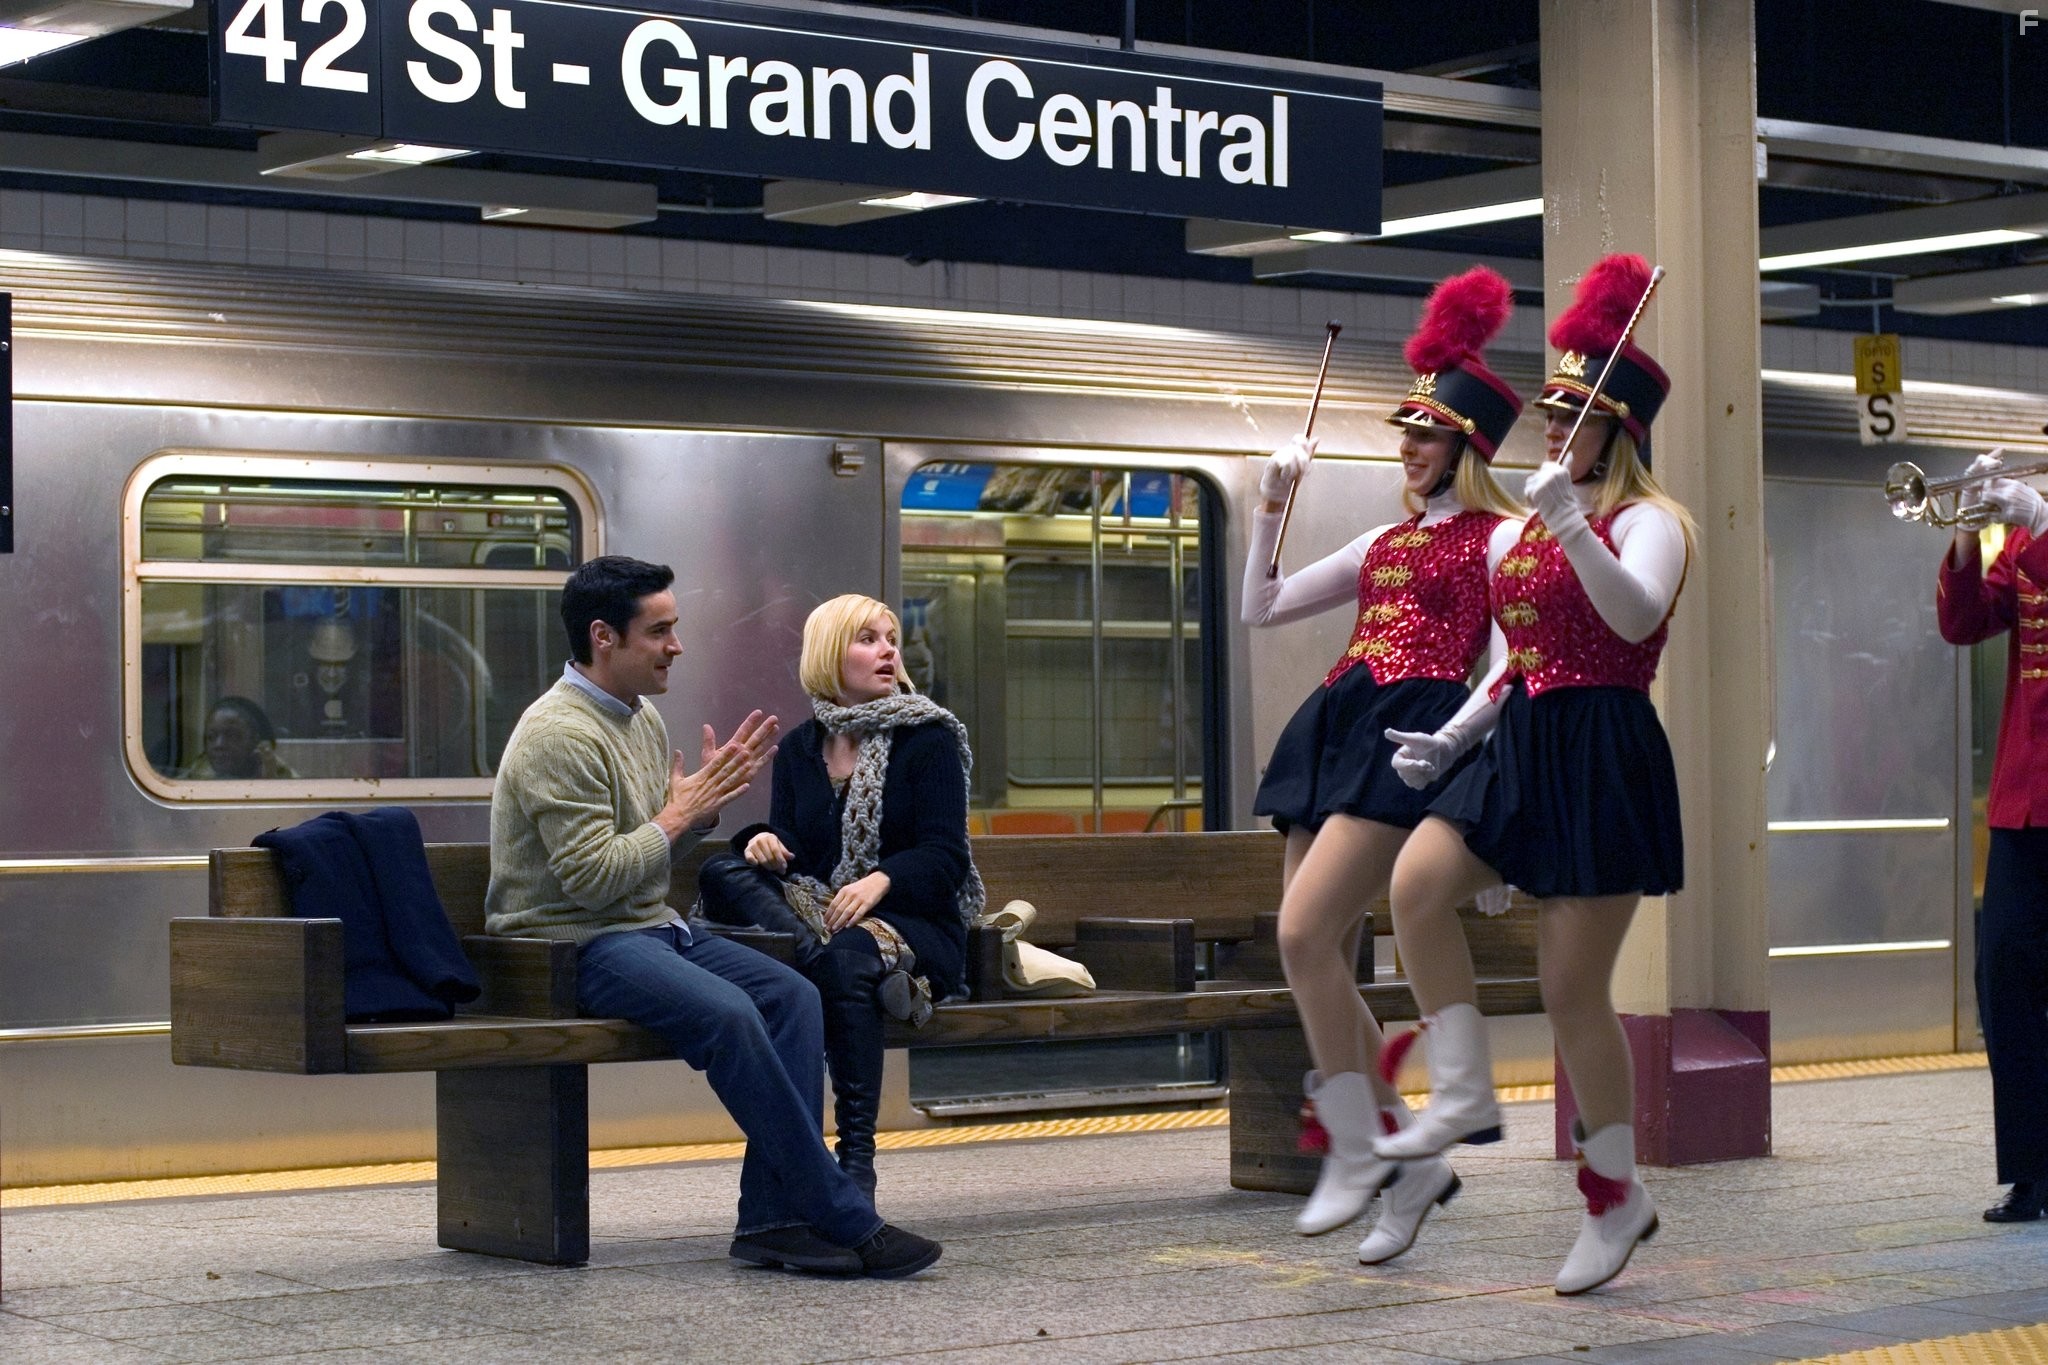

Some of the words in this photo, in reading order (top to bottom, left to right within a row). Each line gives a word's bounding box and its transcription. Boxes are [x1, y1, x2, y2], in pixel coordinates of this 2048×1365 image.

[225, 0, 369, 93] 42
[406, 0, 526, 109] St
[621, 19, 931, 150] Grand
[965, 60, 1288, 188] Central
[1872, 361, 1886, 385] S
[1867, 392, 1896, 437] S
